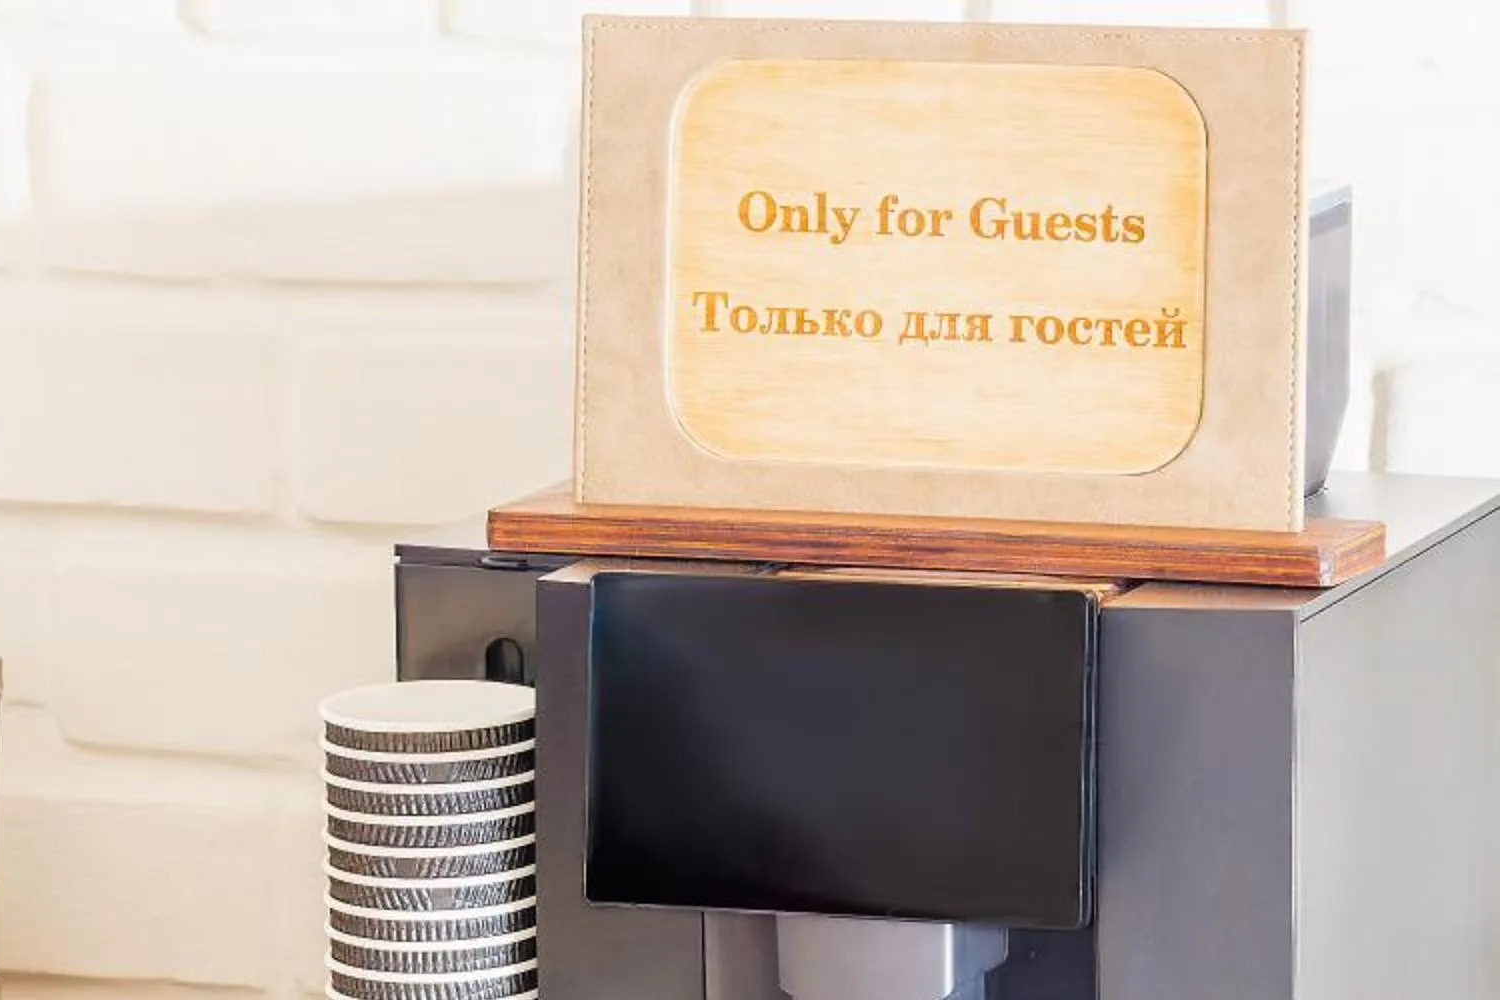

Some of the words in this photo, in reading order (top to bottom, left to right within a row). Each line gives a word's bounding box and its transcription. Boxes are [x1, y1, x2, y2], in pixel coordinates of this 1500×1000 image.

[738, 191, 862, 245] Only
[876, 194, 952, 238] for
[969, 196, 1146, 244] Guests
[693, 291, 882, 338] Только
[898, 312, 992, 346] для
[1008, 306, 1187, 350] гостей
